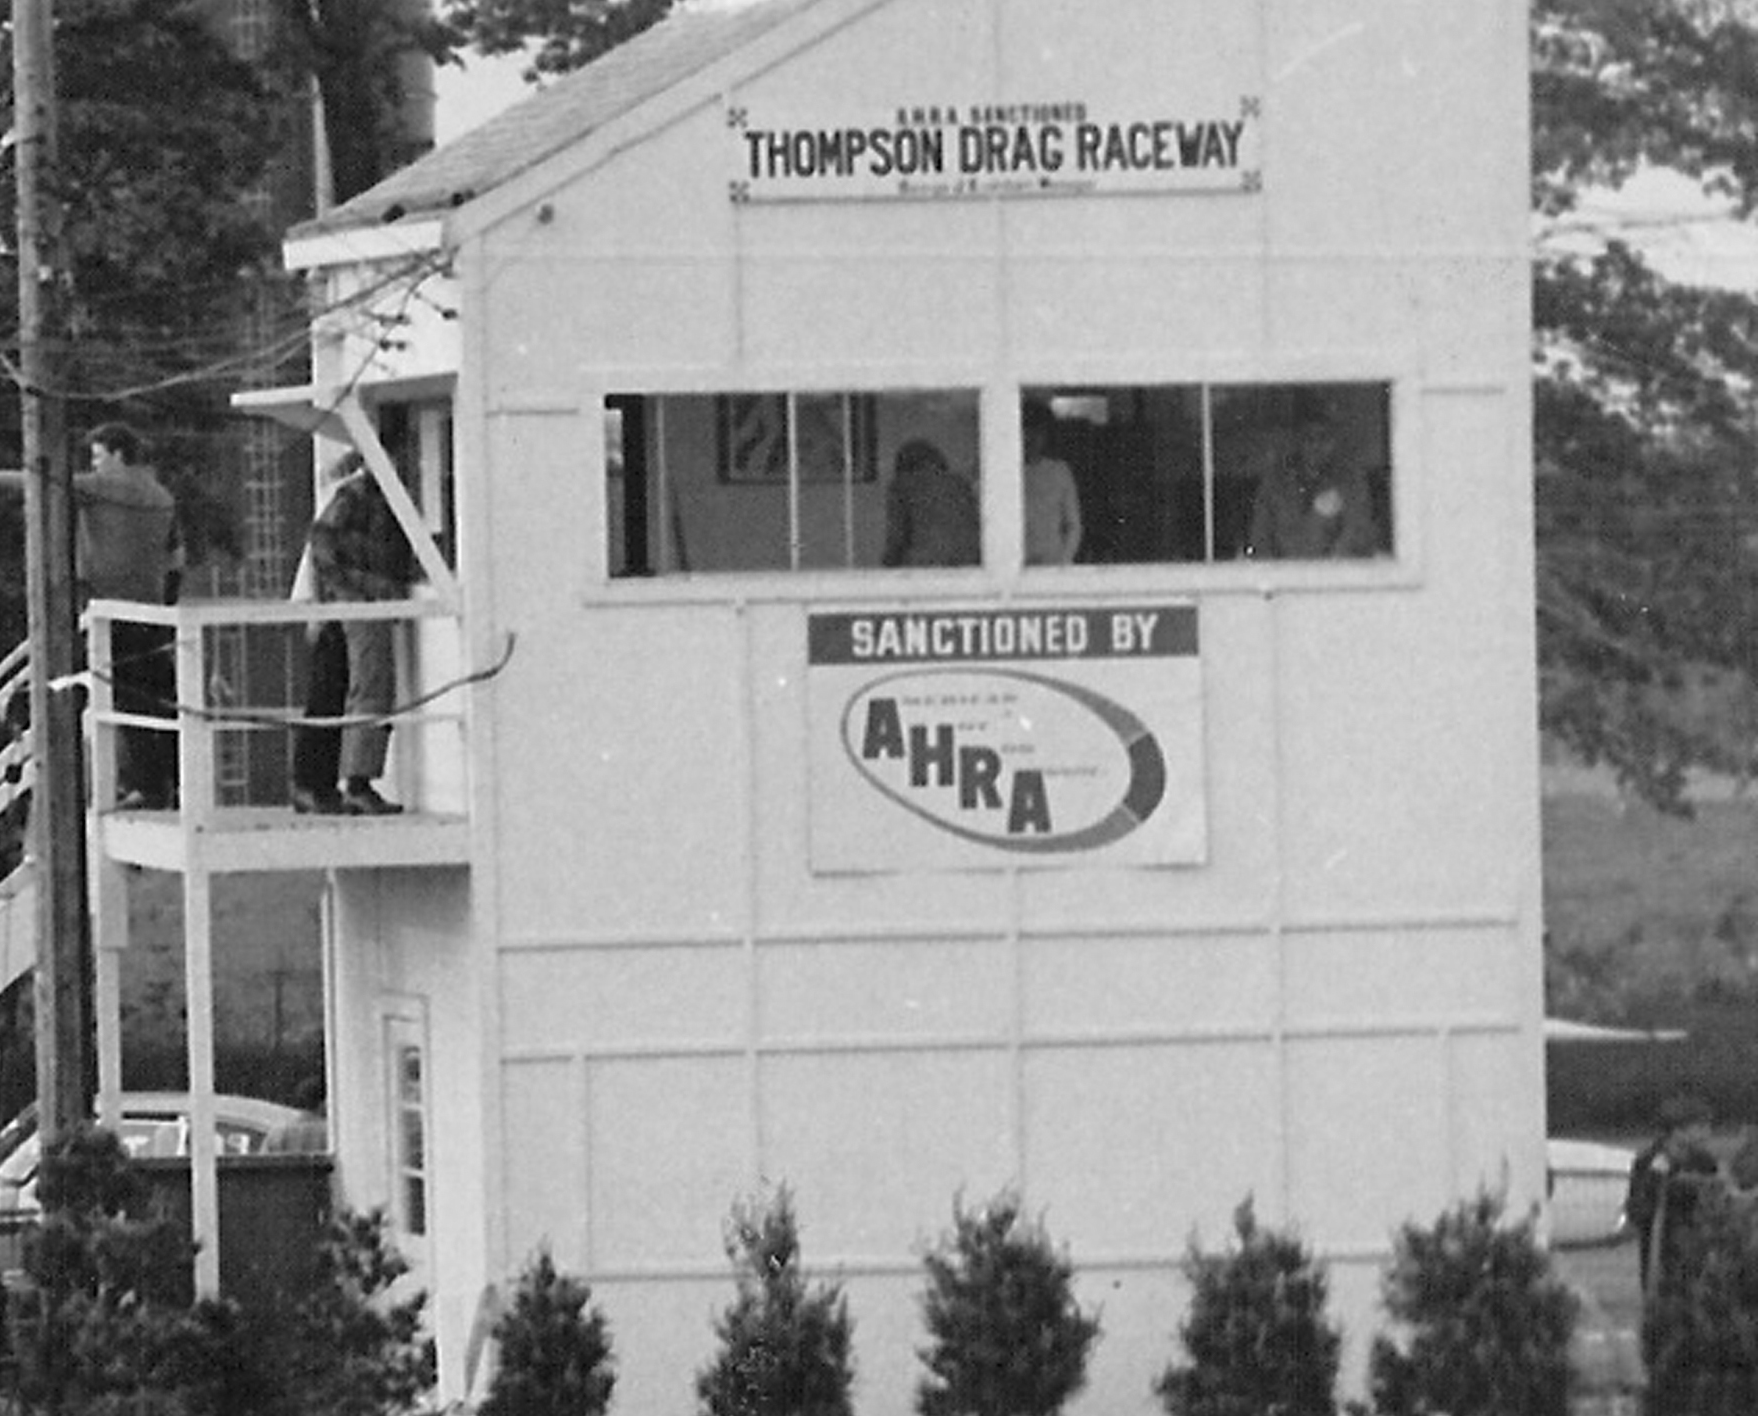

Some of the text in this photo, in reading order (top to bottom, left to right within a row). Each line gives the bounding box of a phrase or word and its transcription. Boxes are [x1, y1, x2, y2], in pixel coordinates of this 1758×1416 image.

[744, 120, 1245, 179] THOMPSON DRAG RACEWAY
[851, 613, 1160, 658] SANCTIONED BY
[862, 696, 1052, 834] AHRA
